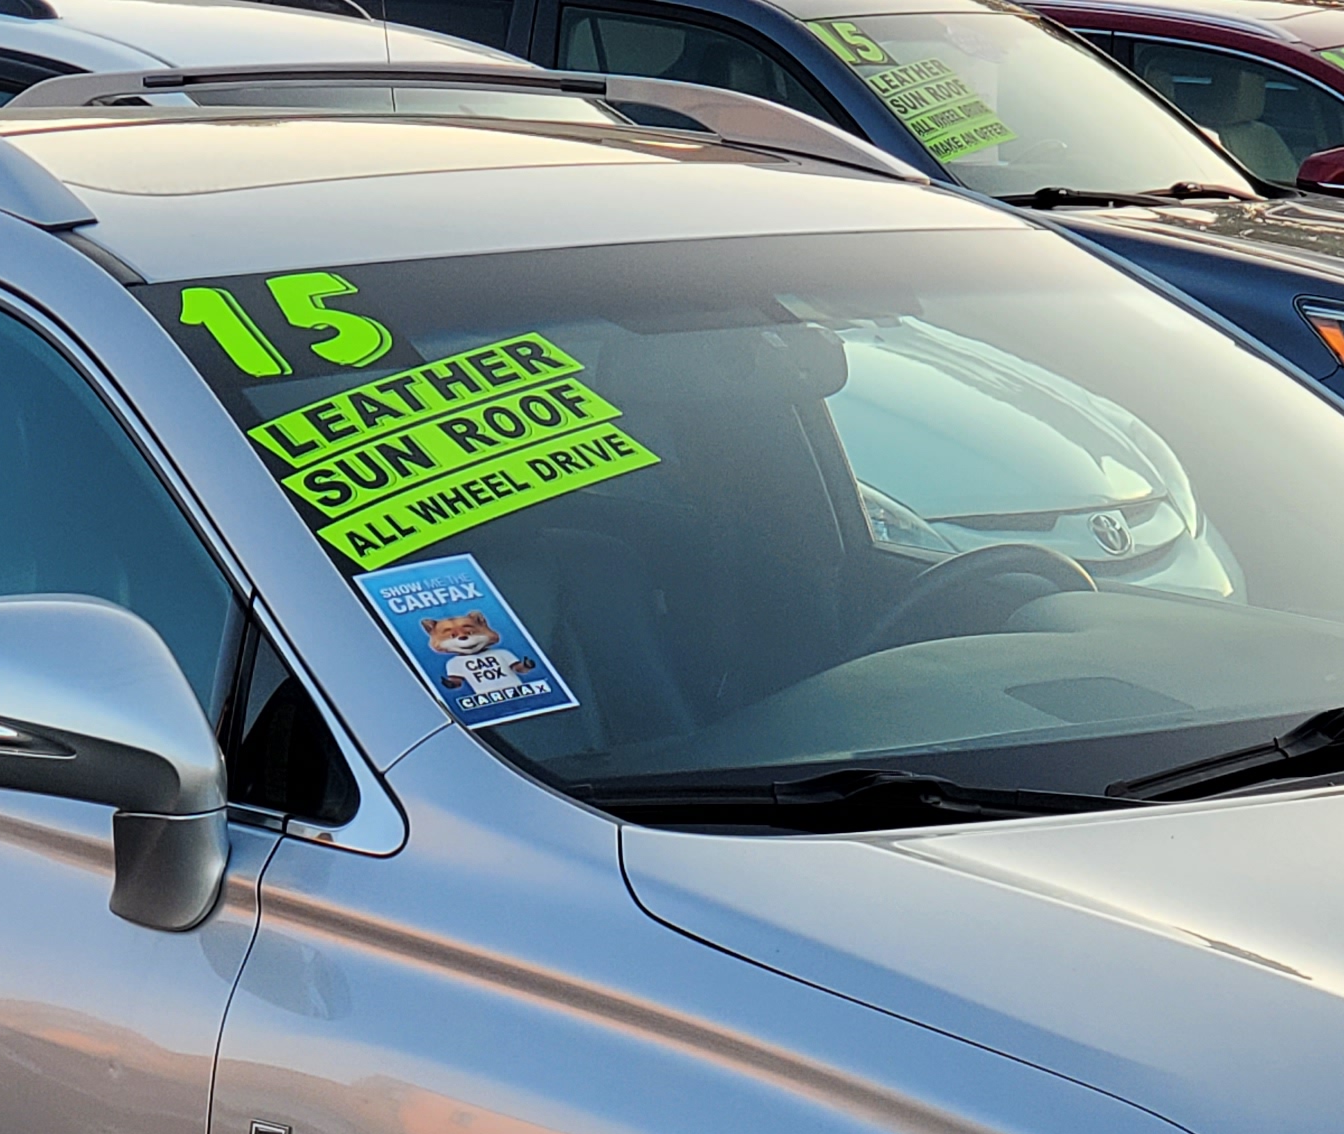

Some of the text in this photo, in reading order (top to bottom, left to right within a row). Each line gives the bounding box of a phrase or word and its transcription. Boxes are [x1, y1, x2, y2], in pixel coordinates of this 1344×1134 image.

[808, 21, 887, 63] 15
[869, 60, 952, 94] LEATHER
[890, 79, 969, 114] SUN ROOF
[911, 118, 935, 136] ALL
[930, 109, 962, 129] WHEEL
[929, 122, 1012, 157] MAKE AN OFFER
[179, 272, 393, 378] 15
[266, 339, 560, 460] LEATHER
[303, 382, 592, 508] SUN ROOF
[345, 432, 636, 558] ALL WHEEL DRIVE
[379, 572, 472, 600] SHOW ME THE
[388, 582, 484, 614] CARFAX
[465, 655, 500, 672] CAR
[473, 667, 508, 684] FOX
[459, 682, 549, 708] CARFAX
